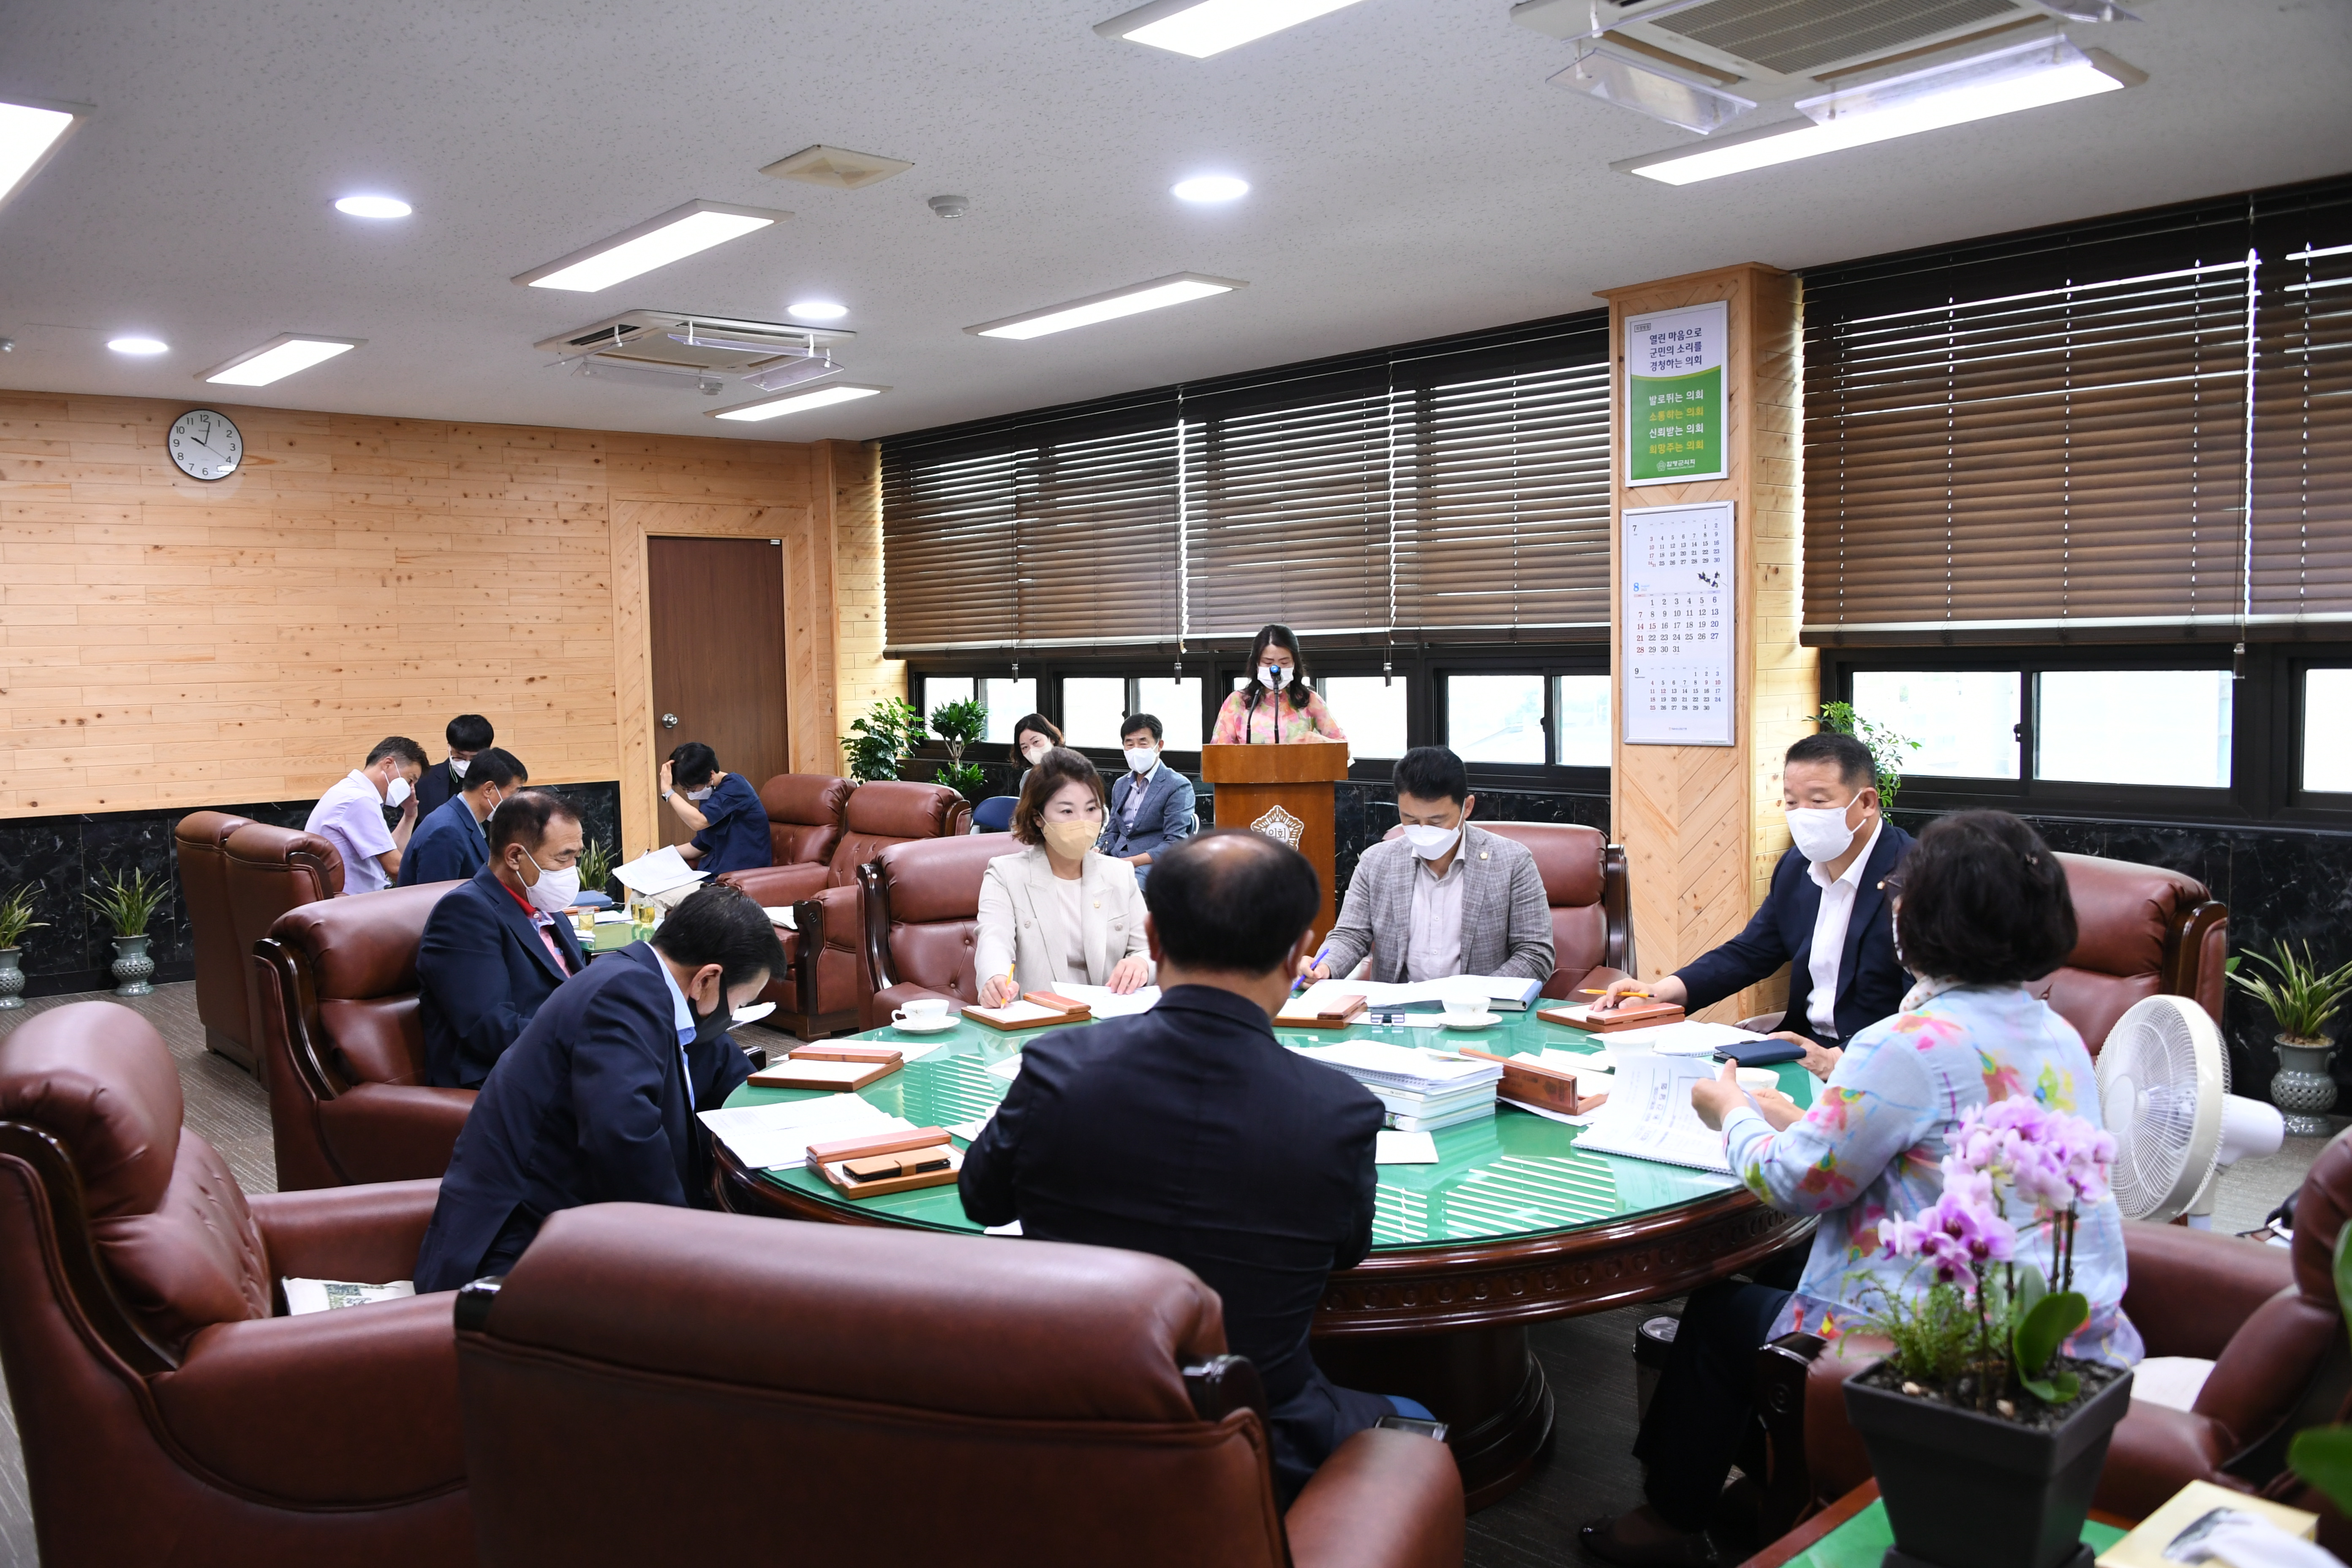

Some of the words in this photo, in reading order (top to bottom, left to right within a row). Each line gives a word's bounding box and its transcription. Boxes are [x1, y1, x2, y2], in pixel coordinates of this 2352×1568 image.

[1650, 333, 1666, 345] 열린
[1669, 328, 1702, 341] 마음으로
[1650, 345, 1674, 358] 군민의
[1677, 341, 1702, 353] 소리를
[1650, 358, 1682, 372] 경청하는
[1685, 355, 1701, 366] 의회
[1649, 392, 1683, 406] 발로뛰는
[1686, 389, 1703, 400] 의회
[200, 414, 209, 422] 12
[1649, 409, 1683, 421] 소통하는
[1686, 406, 1704, 417] 의회
[175, 426, 185, 434] 10
[1649, 426, 1683, 438] 신뢰받는
[1686, 423, 1703, 434] 의회
[173, 439, 180, 447] 9
[230, 443, 236, 451] 3
[1649, 442, 1683, 454] 희망주는
[1686, 439, 1704, 451] 의회
[177, 452, 184, 460] 8
[202, 468, 209, 476] 6
[1633, 583, 1639, 591] 8
[1269, 828, 1286, 840] 의회
